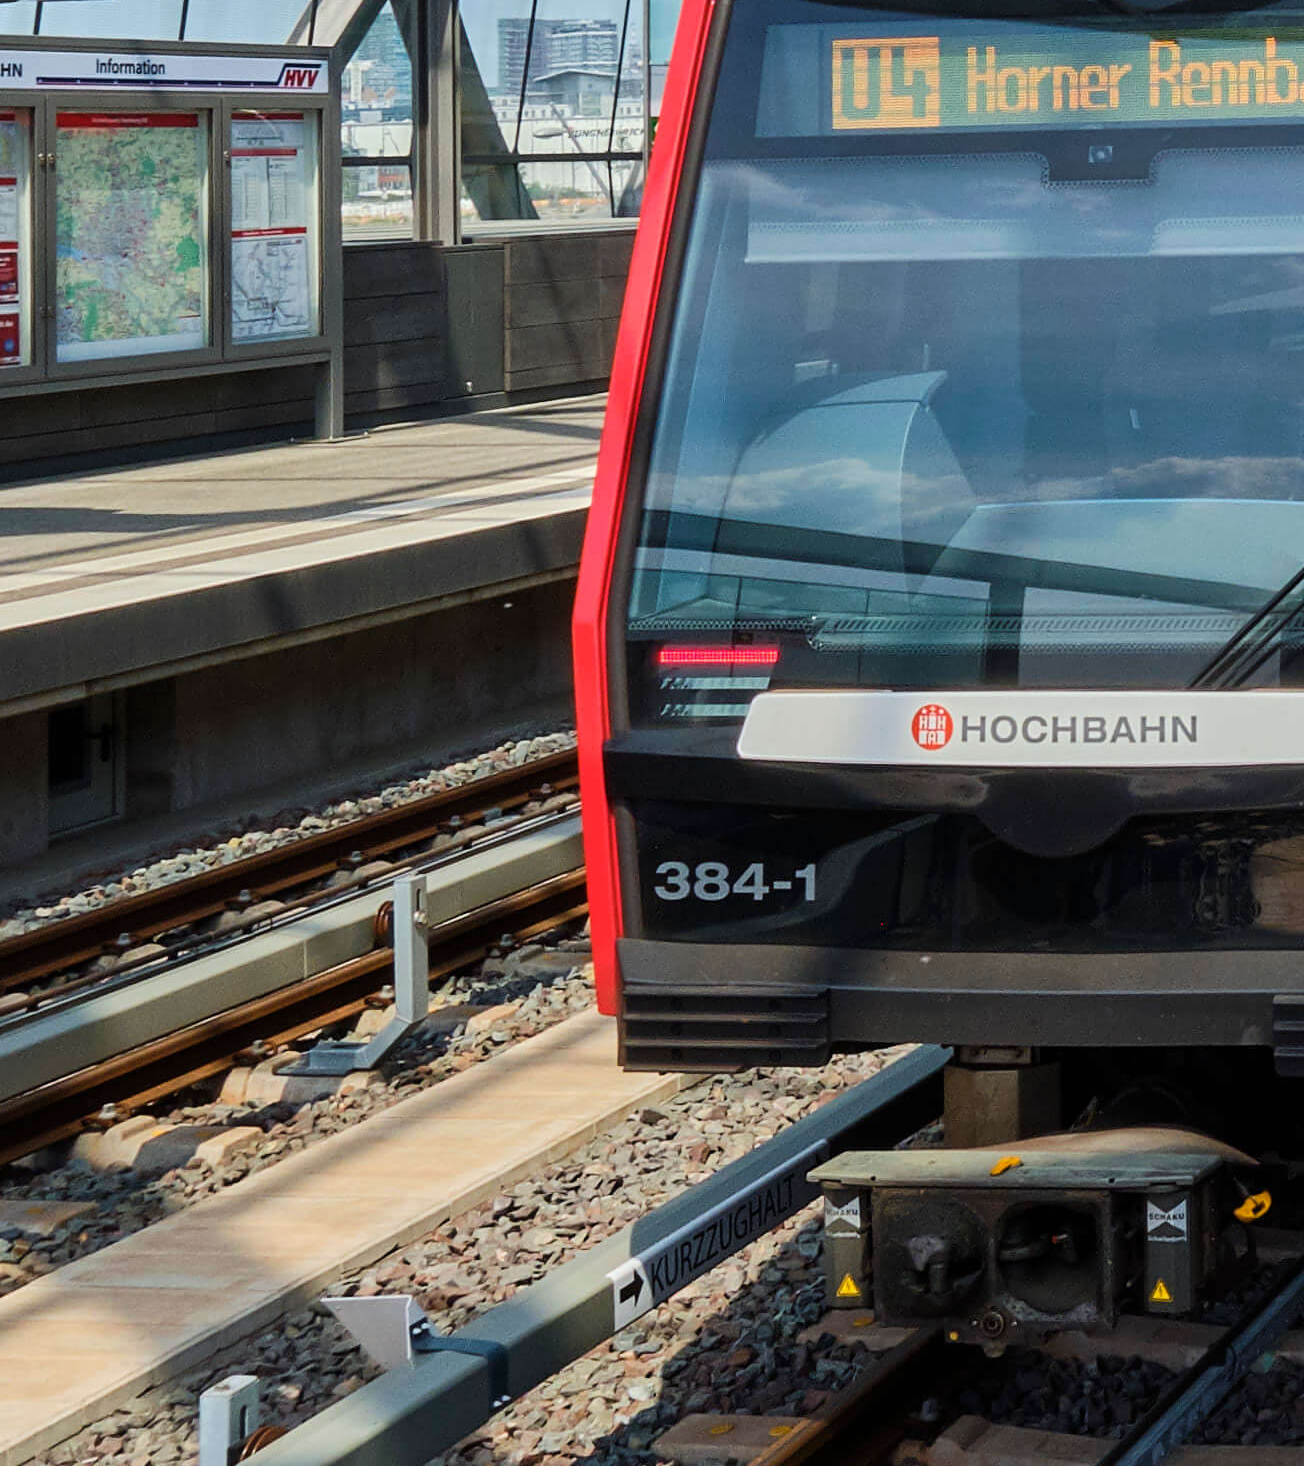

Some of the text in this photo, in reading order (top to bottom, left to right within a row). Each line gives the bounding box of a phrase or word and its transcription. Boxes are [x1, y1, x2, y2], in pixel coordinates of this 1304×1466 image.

[95, 58, 166, 75] Information
[284, 69, 319, 88] HVV
[836, 42, 937, 124] U4
[967, 46, 1133, 114] Horner
[961, 715, 1198, 744] HOCHBAHN
[654, 861, 816, 901] 384-1
[651, 1173, 796, 1293] KURZZUGHALT
